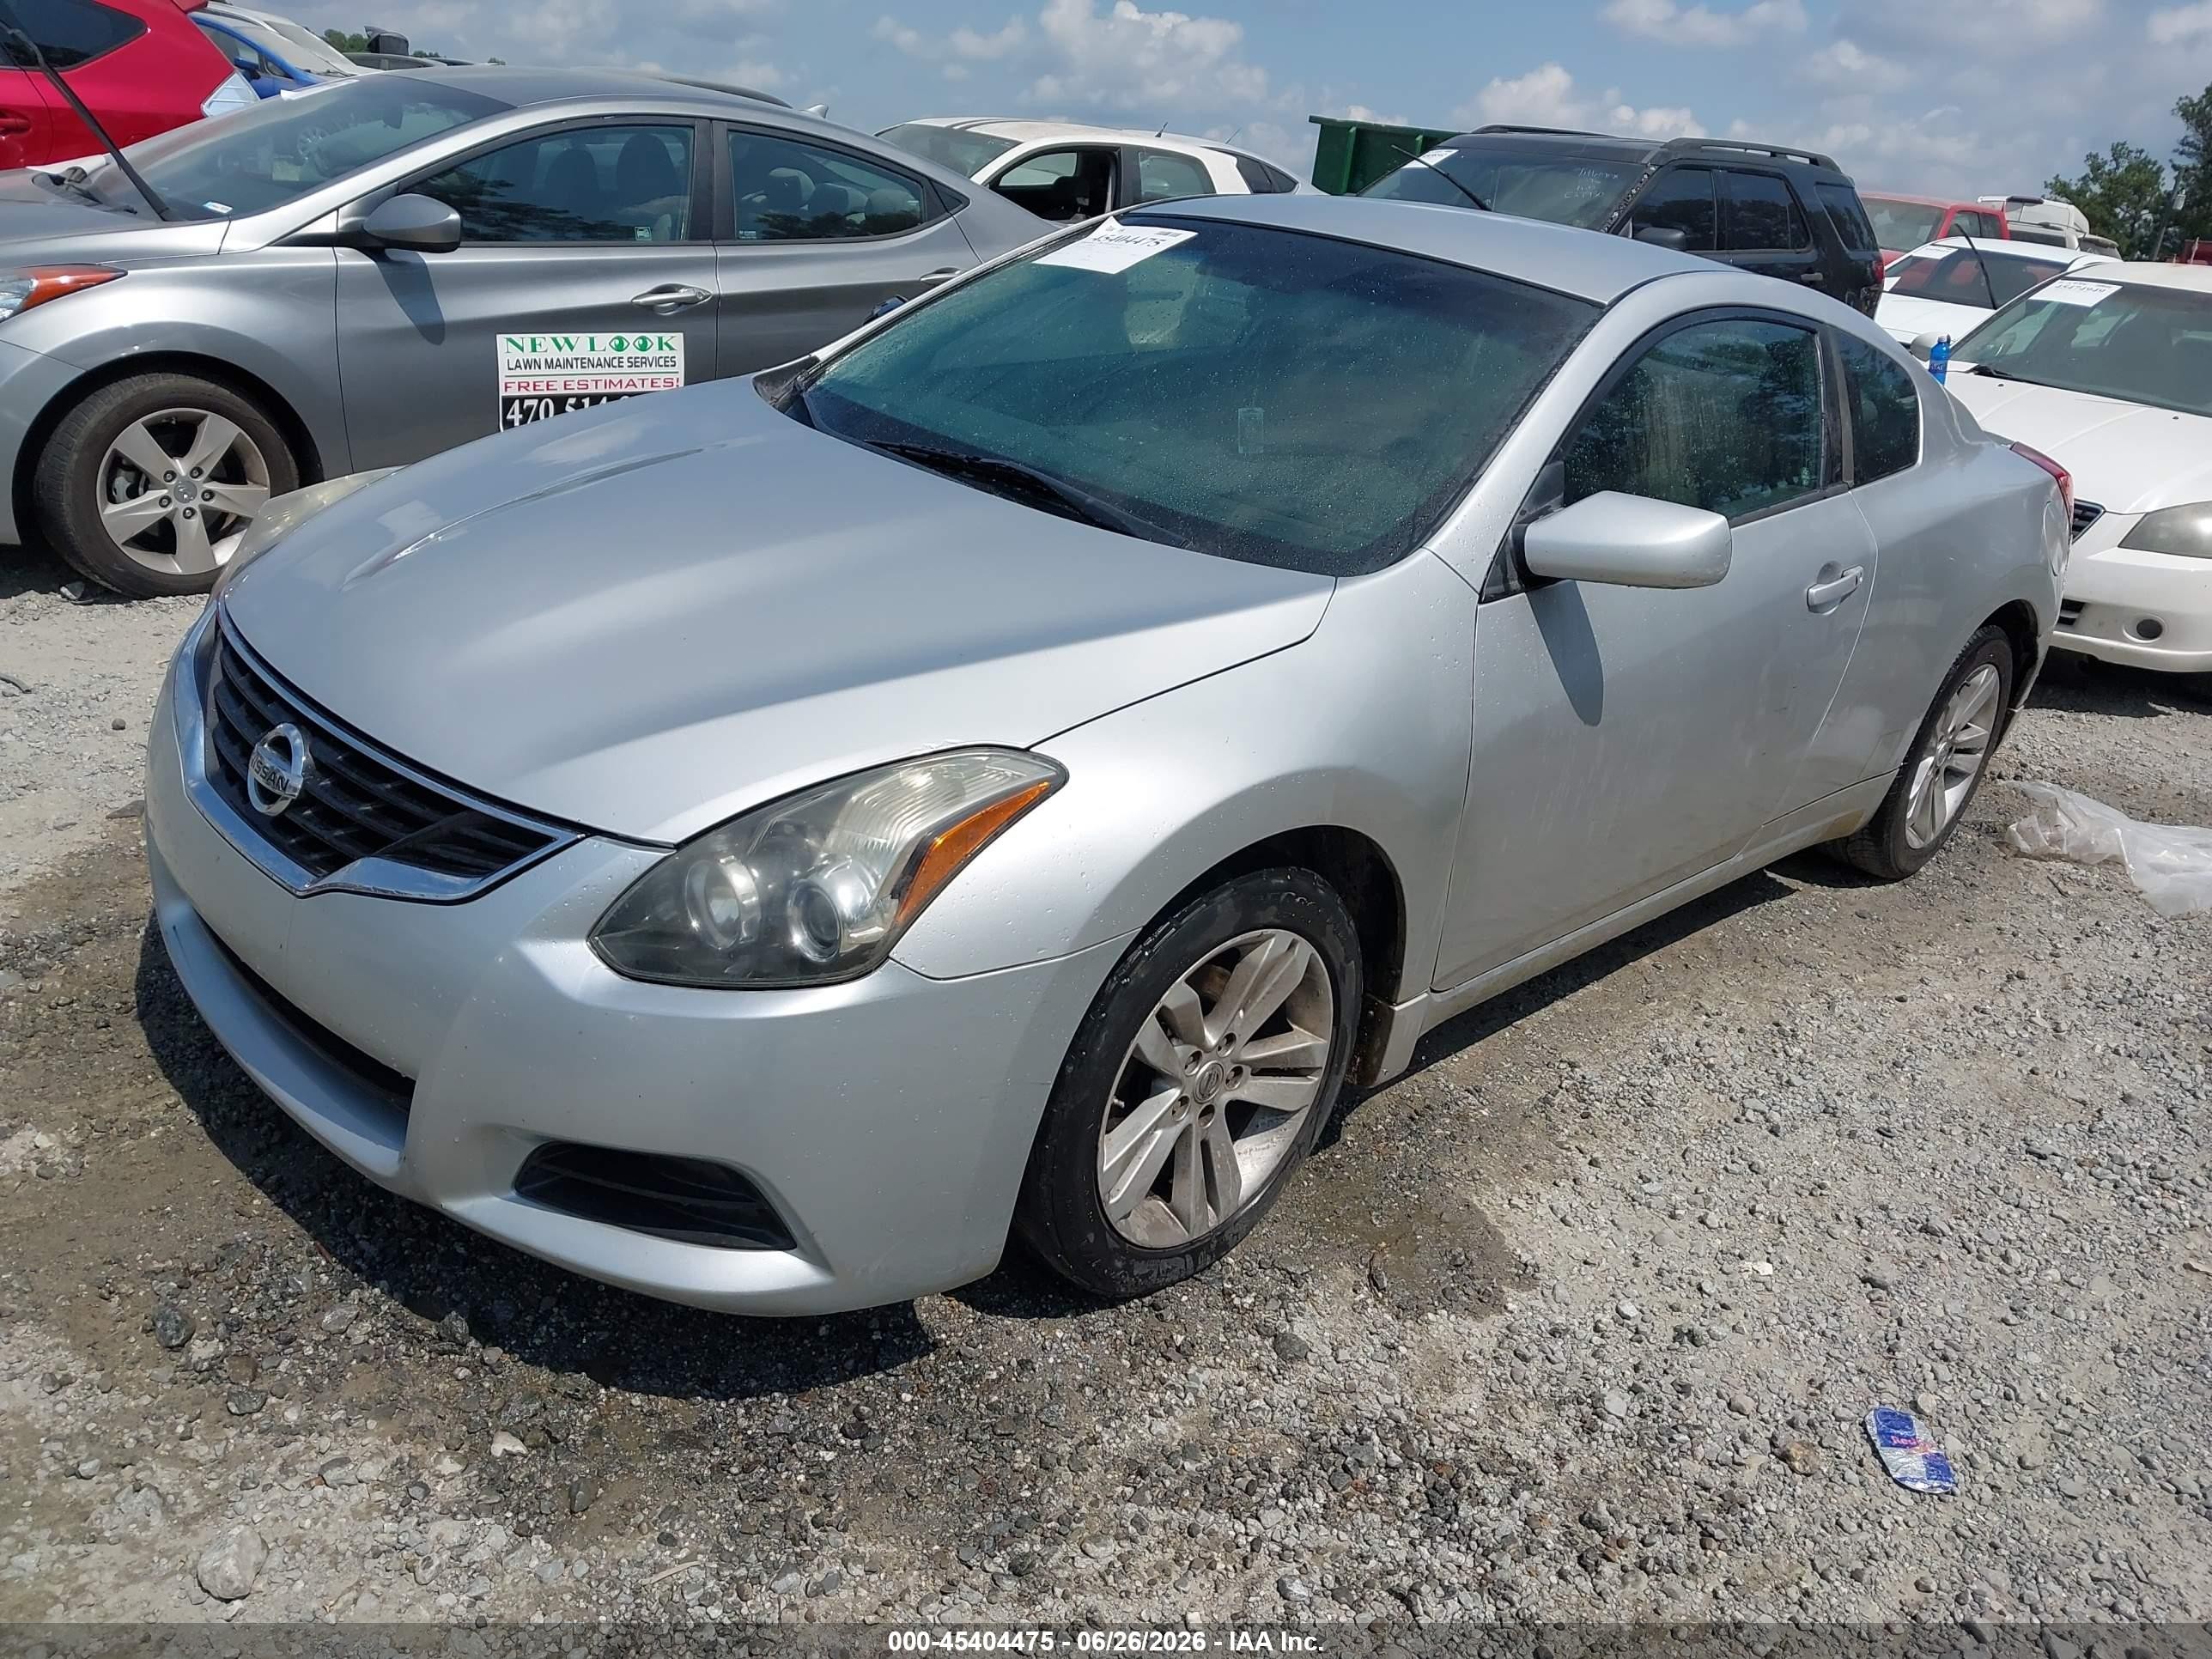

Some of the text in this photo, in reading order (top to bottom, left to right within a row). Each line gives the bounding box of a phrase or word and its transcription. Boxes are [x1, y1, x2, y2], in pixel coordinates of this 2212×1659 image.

[504, 336, 580, 353] NEW
[507, 356, 677, 370] LAWN MAINTENANCE SERVICES
[504, 378, 680, 392] FREE ESTIMATES!
